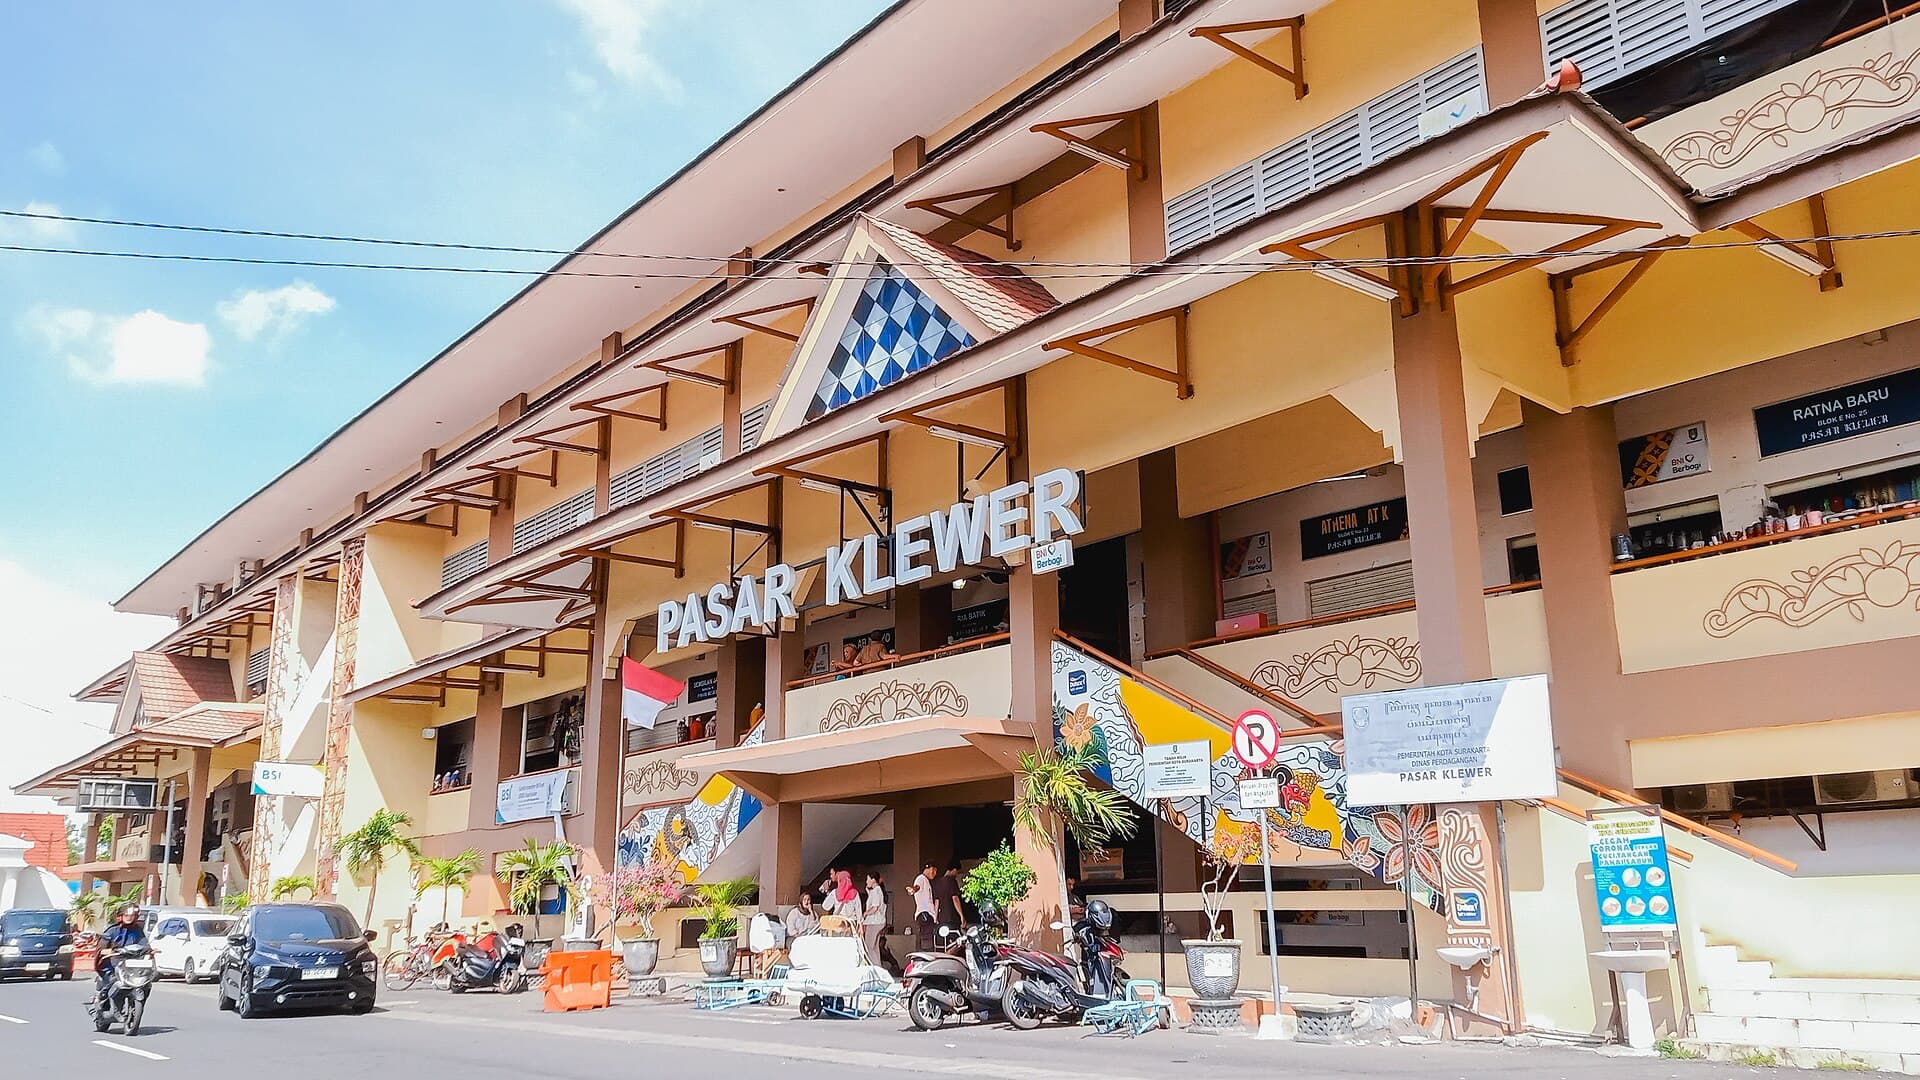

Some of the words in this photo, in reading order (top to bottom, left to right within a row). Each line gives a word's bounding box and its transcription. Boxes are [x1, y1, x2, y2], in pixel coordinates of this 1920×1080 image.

[1793, 400, 1843, 421] RATNA
[1847, 387, 1889, 408] BARU
[1818, 417, 1838, 427] BLOK
[1801, 426, 1840, 443] PASAR
[1672, 458, 1685, 466] BNI
[1322, 512, 1358, 535] ATHENA
[656, 563, 799, 654] PASAR
[825, 467, 1086, 607] KLEWER
[1036, 549, 1048, 559] BNI
[1037, 554, 1063, 569] Berbagi
[1246, 722, 1264, 756] P
[1398, 750, 1436, 760] PEMERINTAH
[1436, 749, 1452, 758] KOTA
[1411, 760, 1430, 768] DINAS
[1432, 756, 1478, 766] PERDAGANGAN
[1400, 771, 1437, 782] PASAR
[1442, 767, 1493, 780] KLEWER
[502, 784, 513, 801] BSI
[1593, 844, 1630, 853] CORONA
